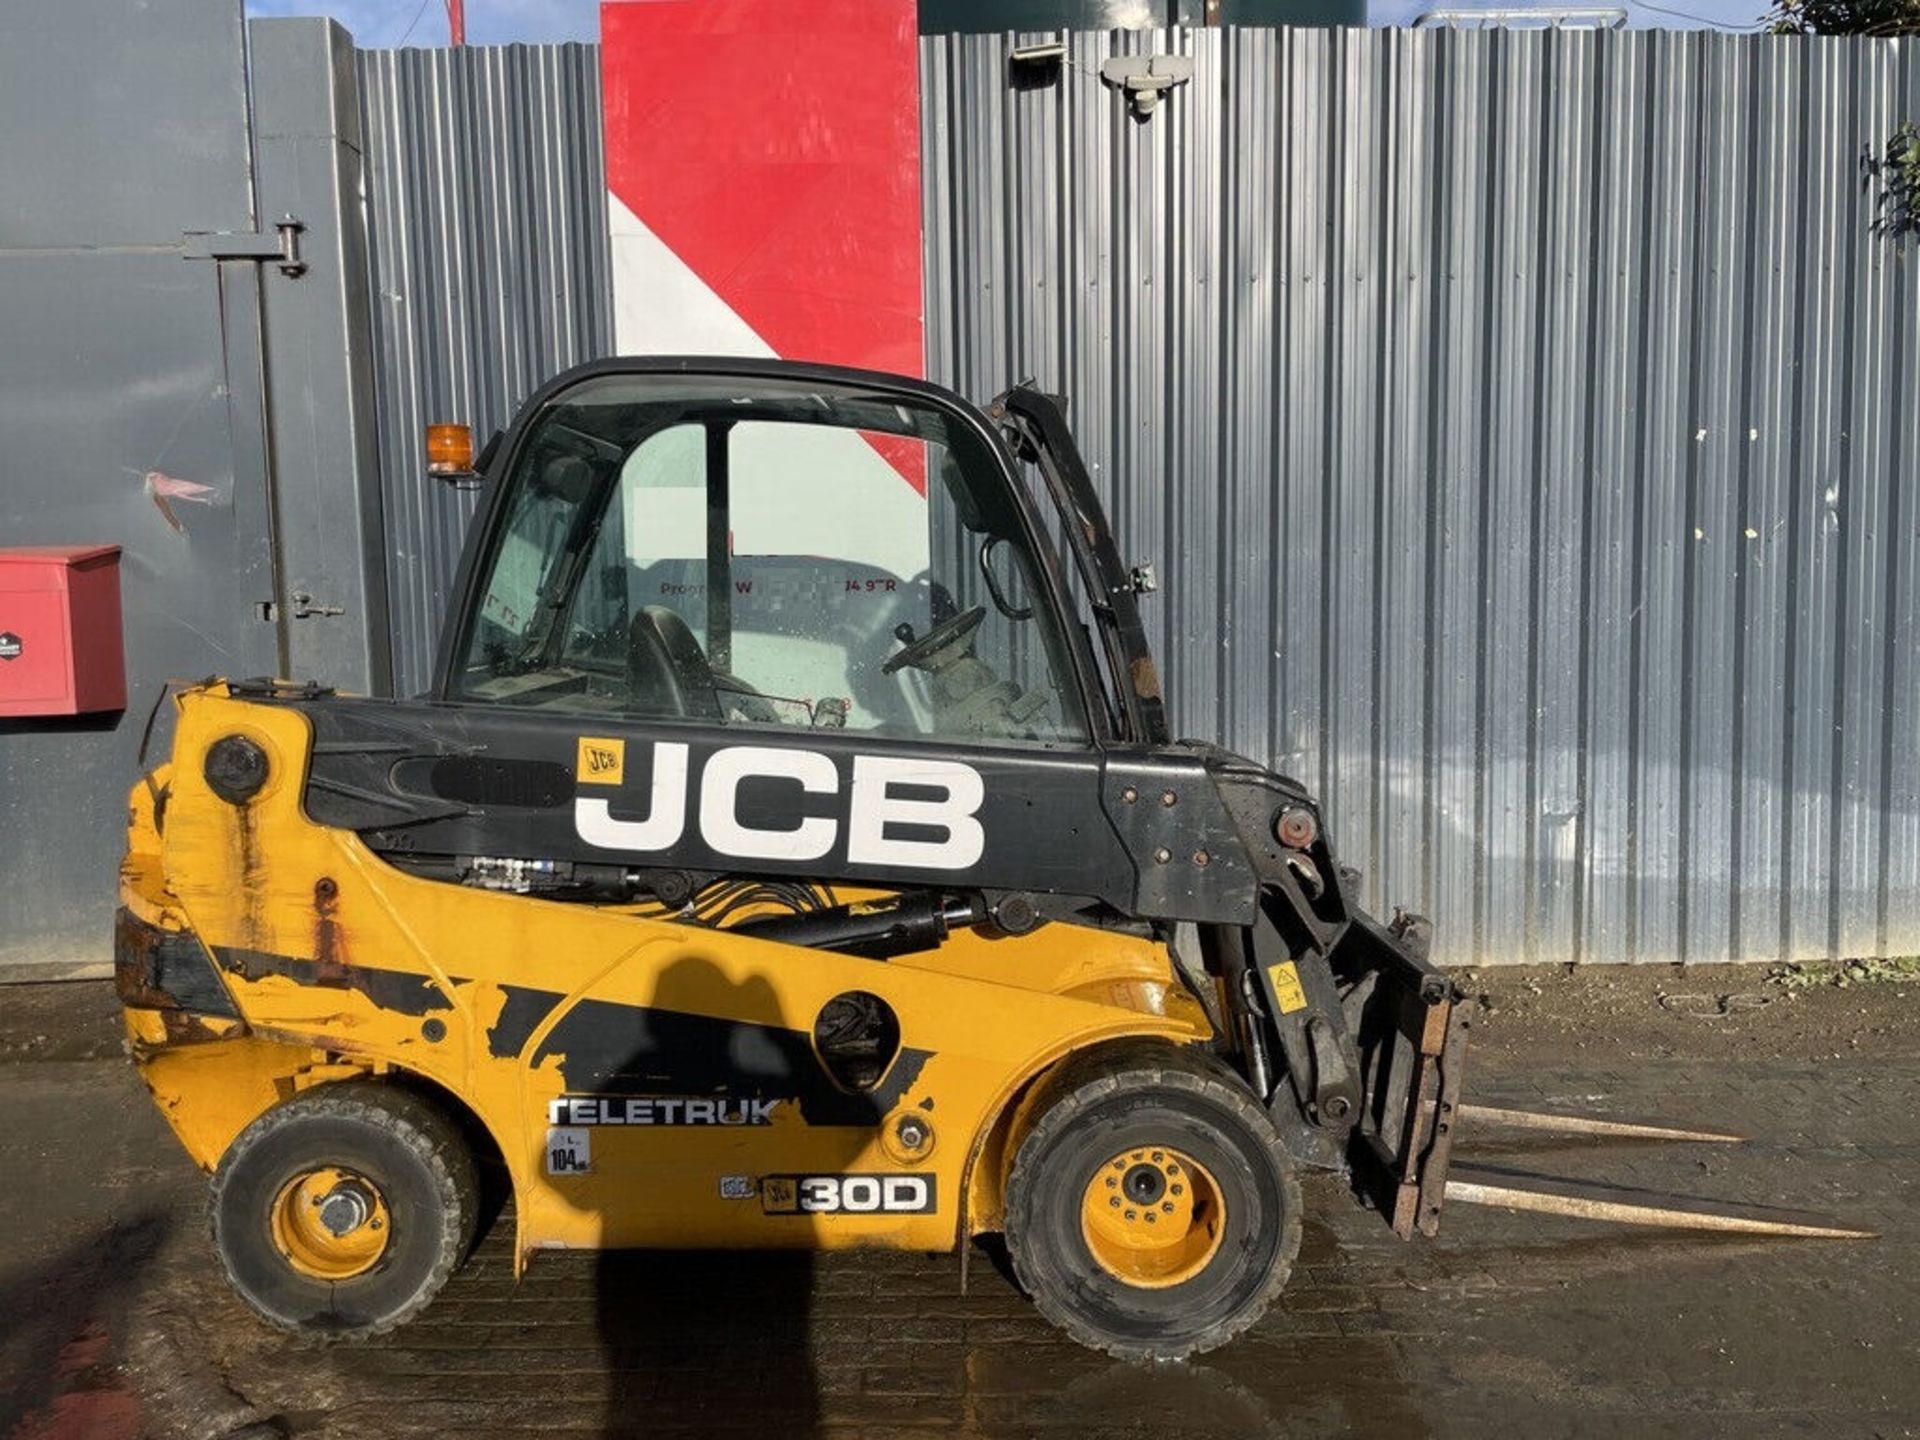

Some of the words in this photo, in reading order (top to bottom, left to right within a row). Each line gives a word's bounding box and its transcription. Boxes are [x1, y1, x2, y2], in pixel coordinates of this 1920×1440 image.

[591, 749, 616, 772] JCB
[575, 741, 985, 870] JCB
[548, 1098, 781, 1125] TELETRUK
[552, 1148, 577, 1171] 104
[801, 1176, 928, 1211] 30D
